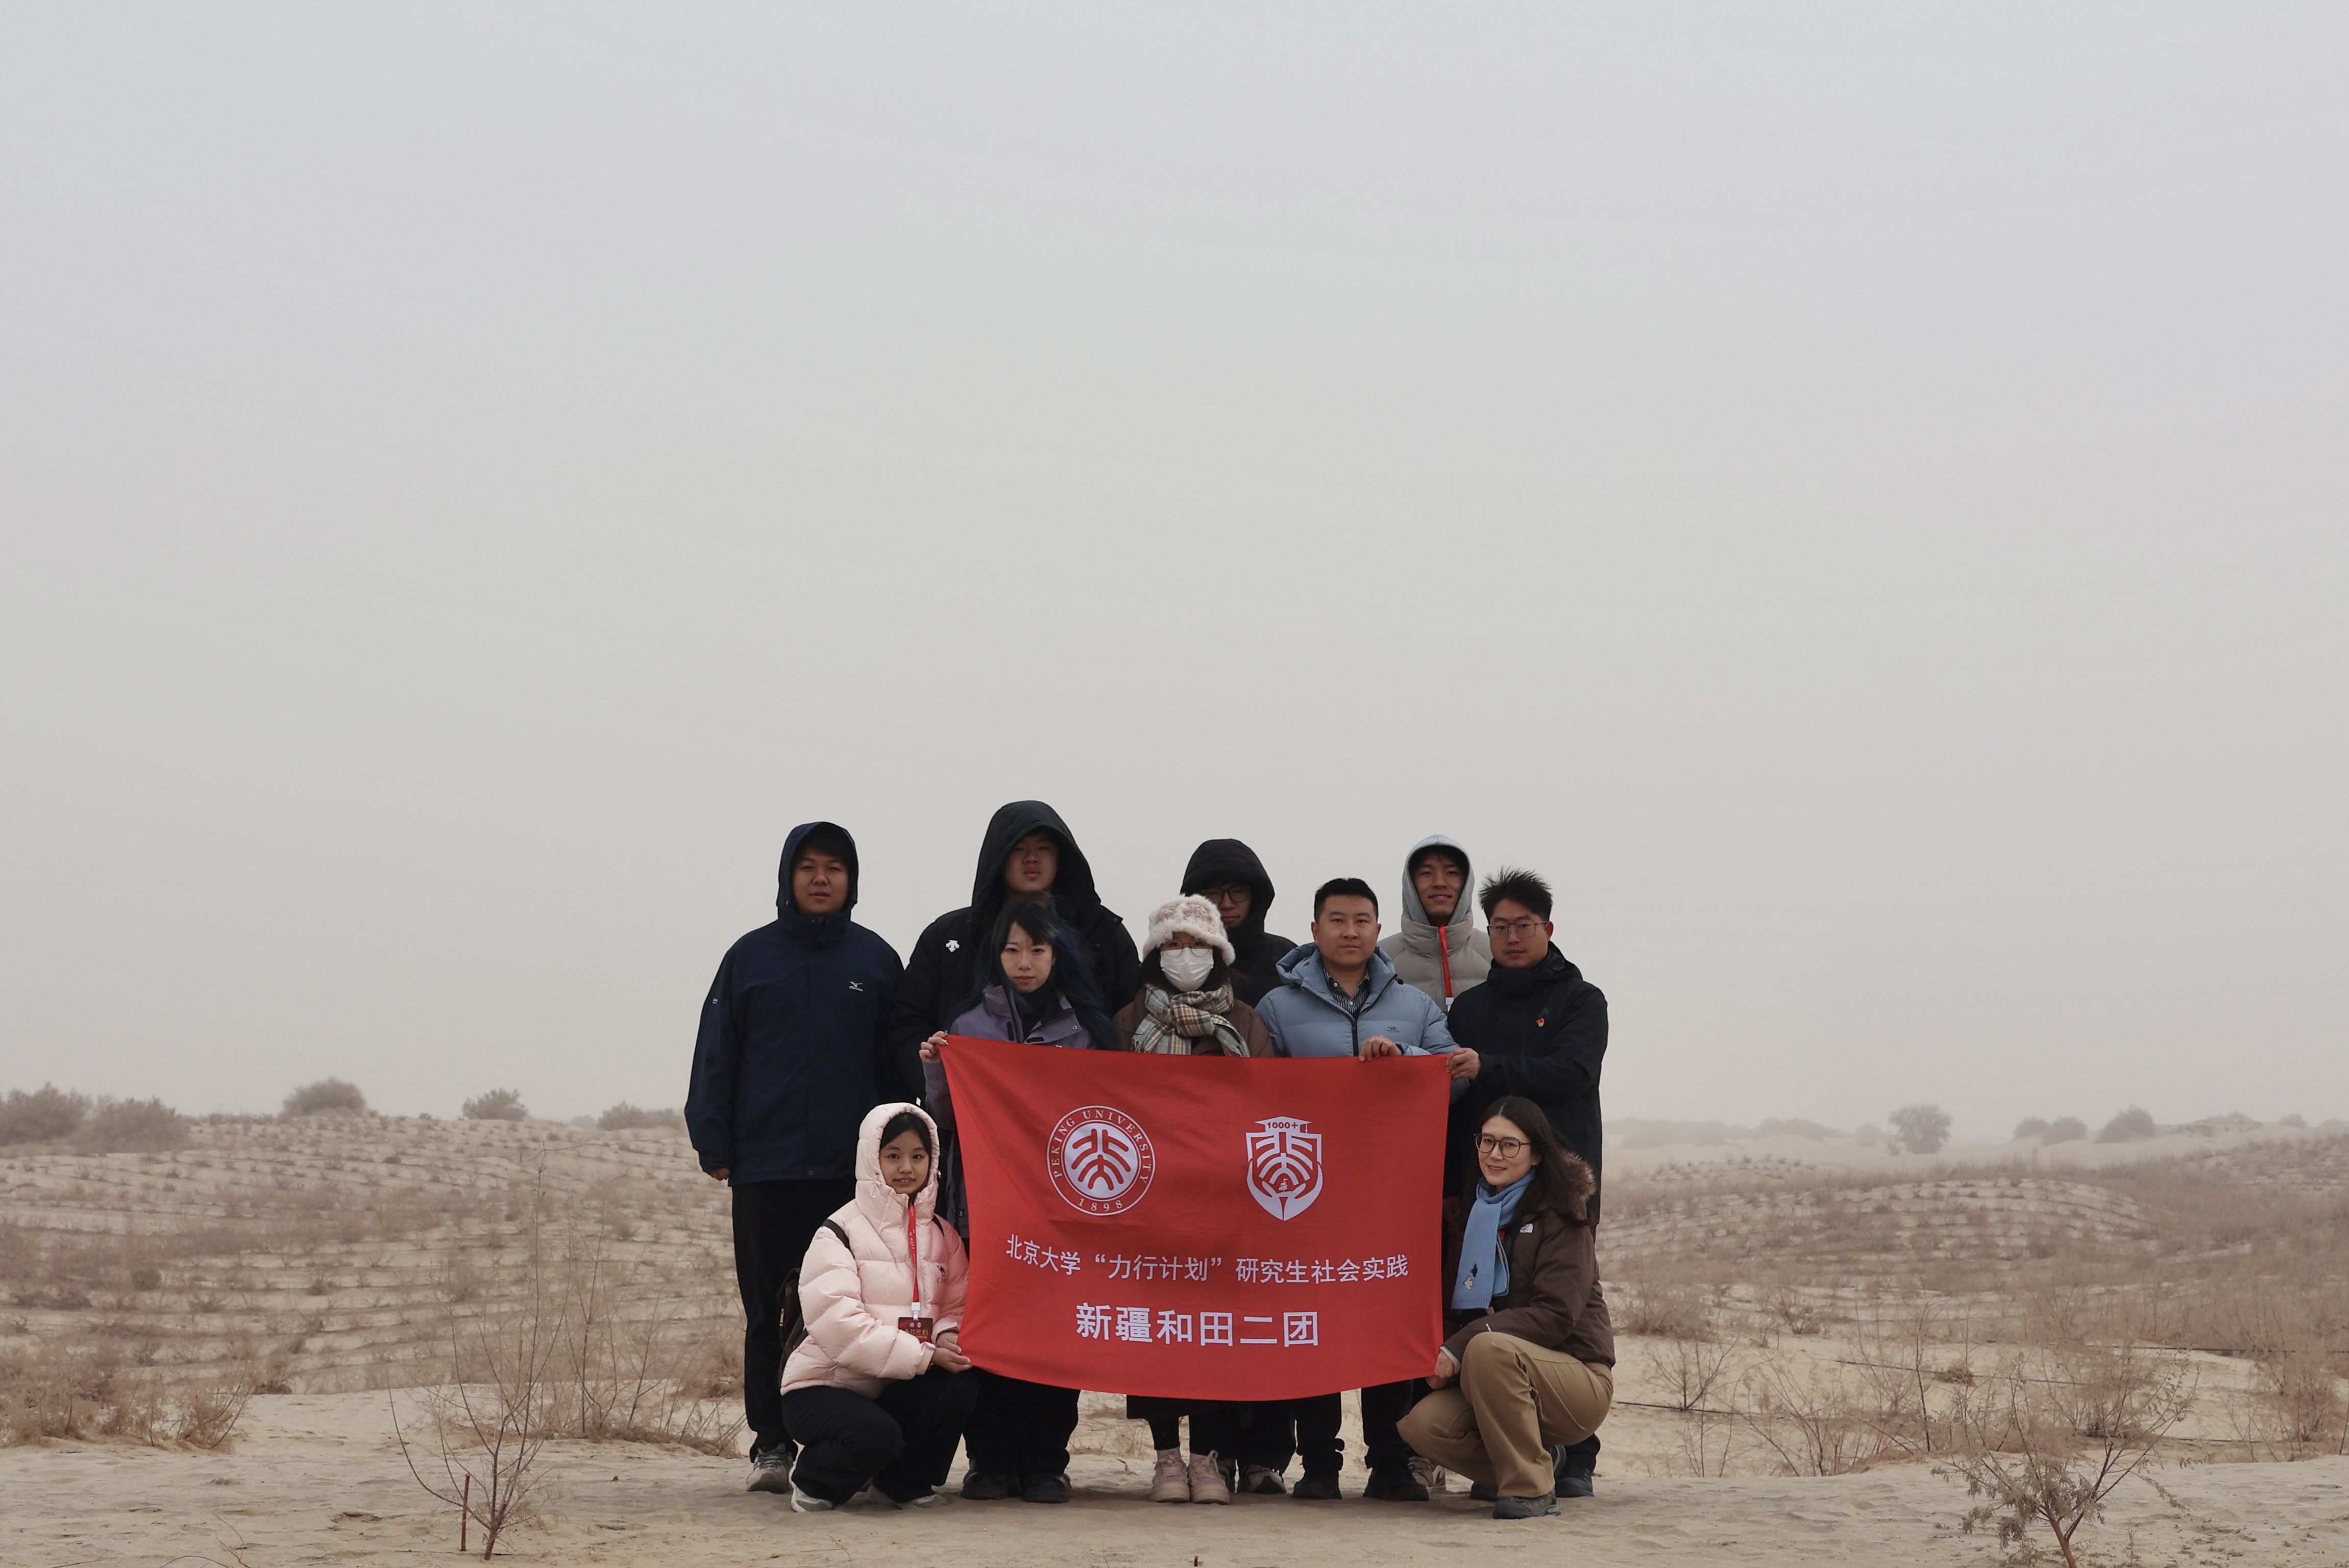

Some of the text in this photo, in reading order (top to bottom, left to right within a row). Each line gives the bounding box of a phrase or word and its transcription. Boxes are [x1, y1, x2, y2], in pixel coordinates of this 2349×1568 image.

[1051, 1110, 1152, 1184] PEKING UNIVERSITY
[1079, 1198, 1123, 1211] 1898
[1076, 1303, 1318, 1347] 新疆和田二团
